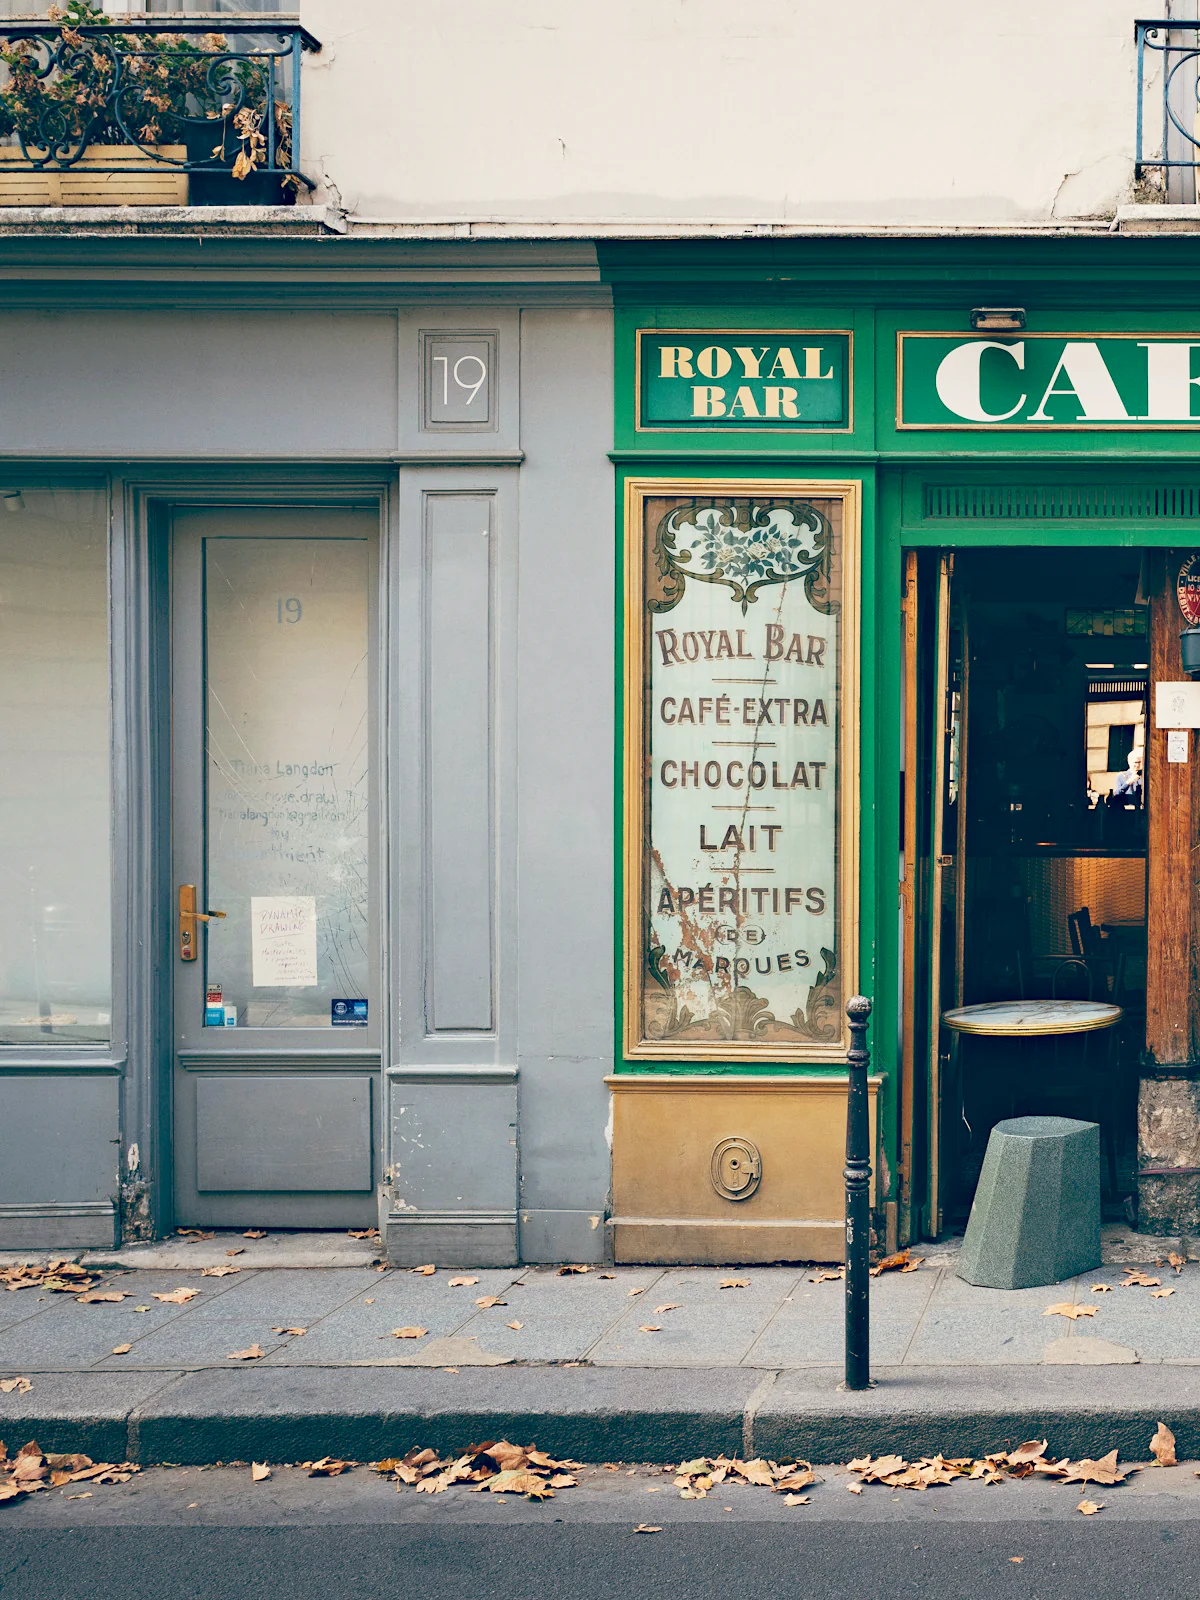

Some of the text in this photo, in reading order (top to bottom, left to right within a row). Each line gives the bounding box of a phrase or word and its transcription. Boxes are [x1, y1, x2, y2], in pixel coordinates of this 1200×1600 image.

[658, 346, 834, 379] ROYAL
[433, 355, 487, 405] 19
[690, 385, 801, 418] BAR
[1180, 554, 1196, 577] VILLE
[277, 597, 302, 624] 19
[655, 623, 828, 668] ROYAL BAR
[660, 693, 829, 726] CAFÉ-EXTRA
[276, 759, 334, 778] Langdon
[660, 759, 827, 791] CHOCOLAT
[699, 825, 783, 852] LAIT
[656, 882, 828, 916] APÉRITIFS
[260, 921, 307, 934] DRAWING
[726, 929, 759, 942] DE
